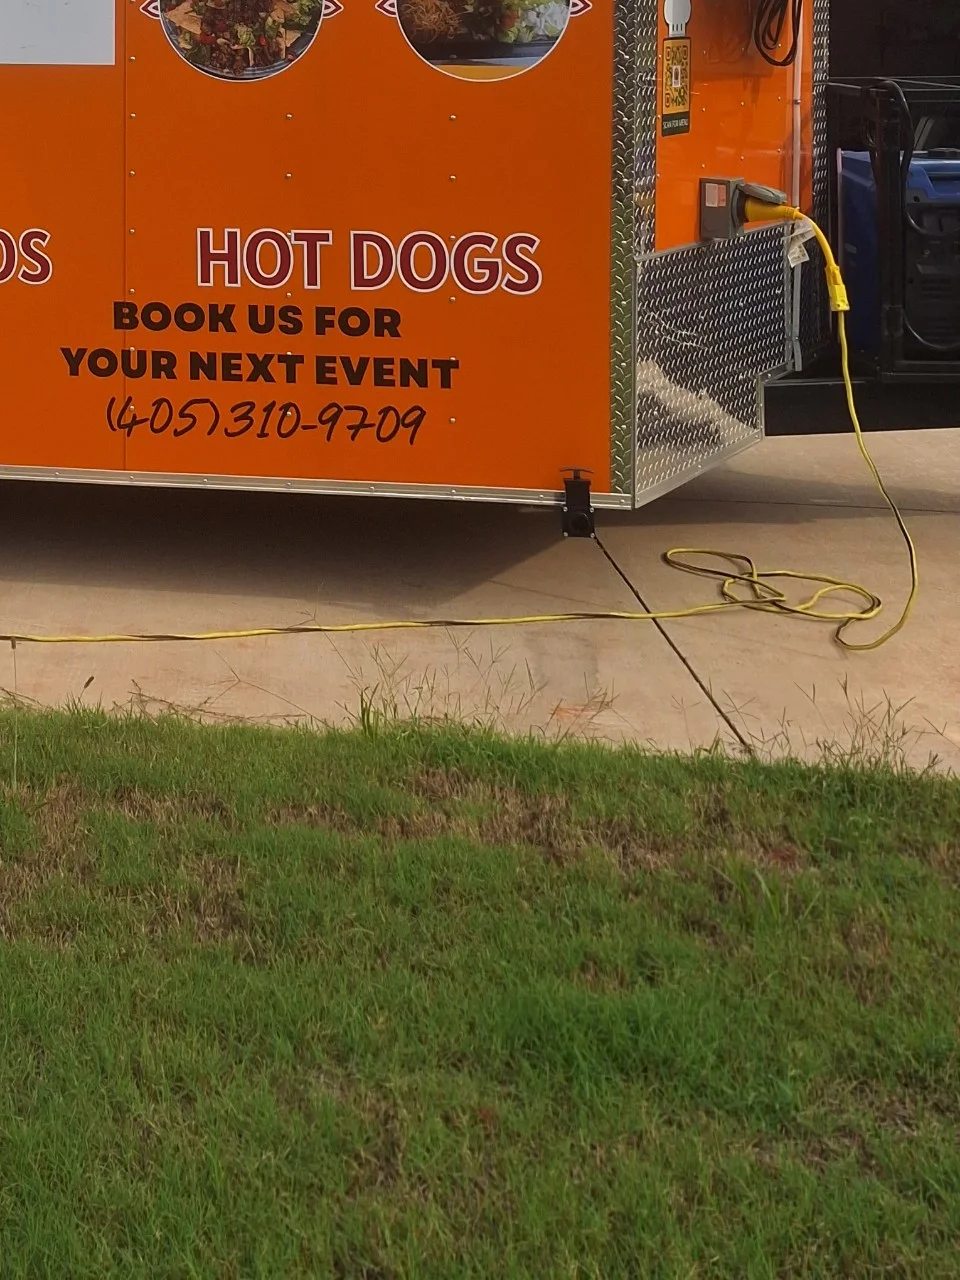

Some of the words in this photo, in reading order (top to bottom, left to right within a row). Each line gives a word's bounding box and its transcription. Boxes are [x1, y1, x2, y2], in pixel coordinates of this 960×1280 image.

[196, 227, 333, 288] HOT
[349, 230, 543, 296] DOGS
[113, 301, 238, 334] BOOK
[247, 304, 304, 336] US
[314, 306, 403, 338] FOR
[59, 347, 178, 381] YOUR
[189, 351, 305, 384] NEXT
[315, 355, 460, 390] EVENT
[106, 395, 427, 445] (405)310-9709
